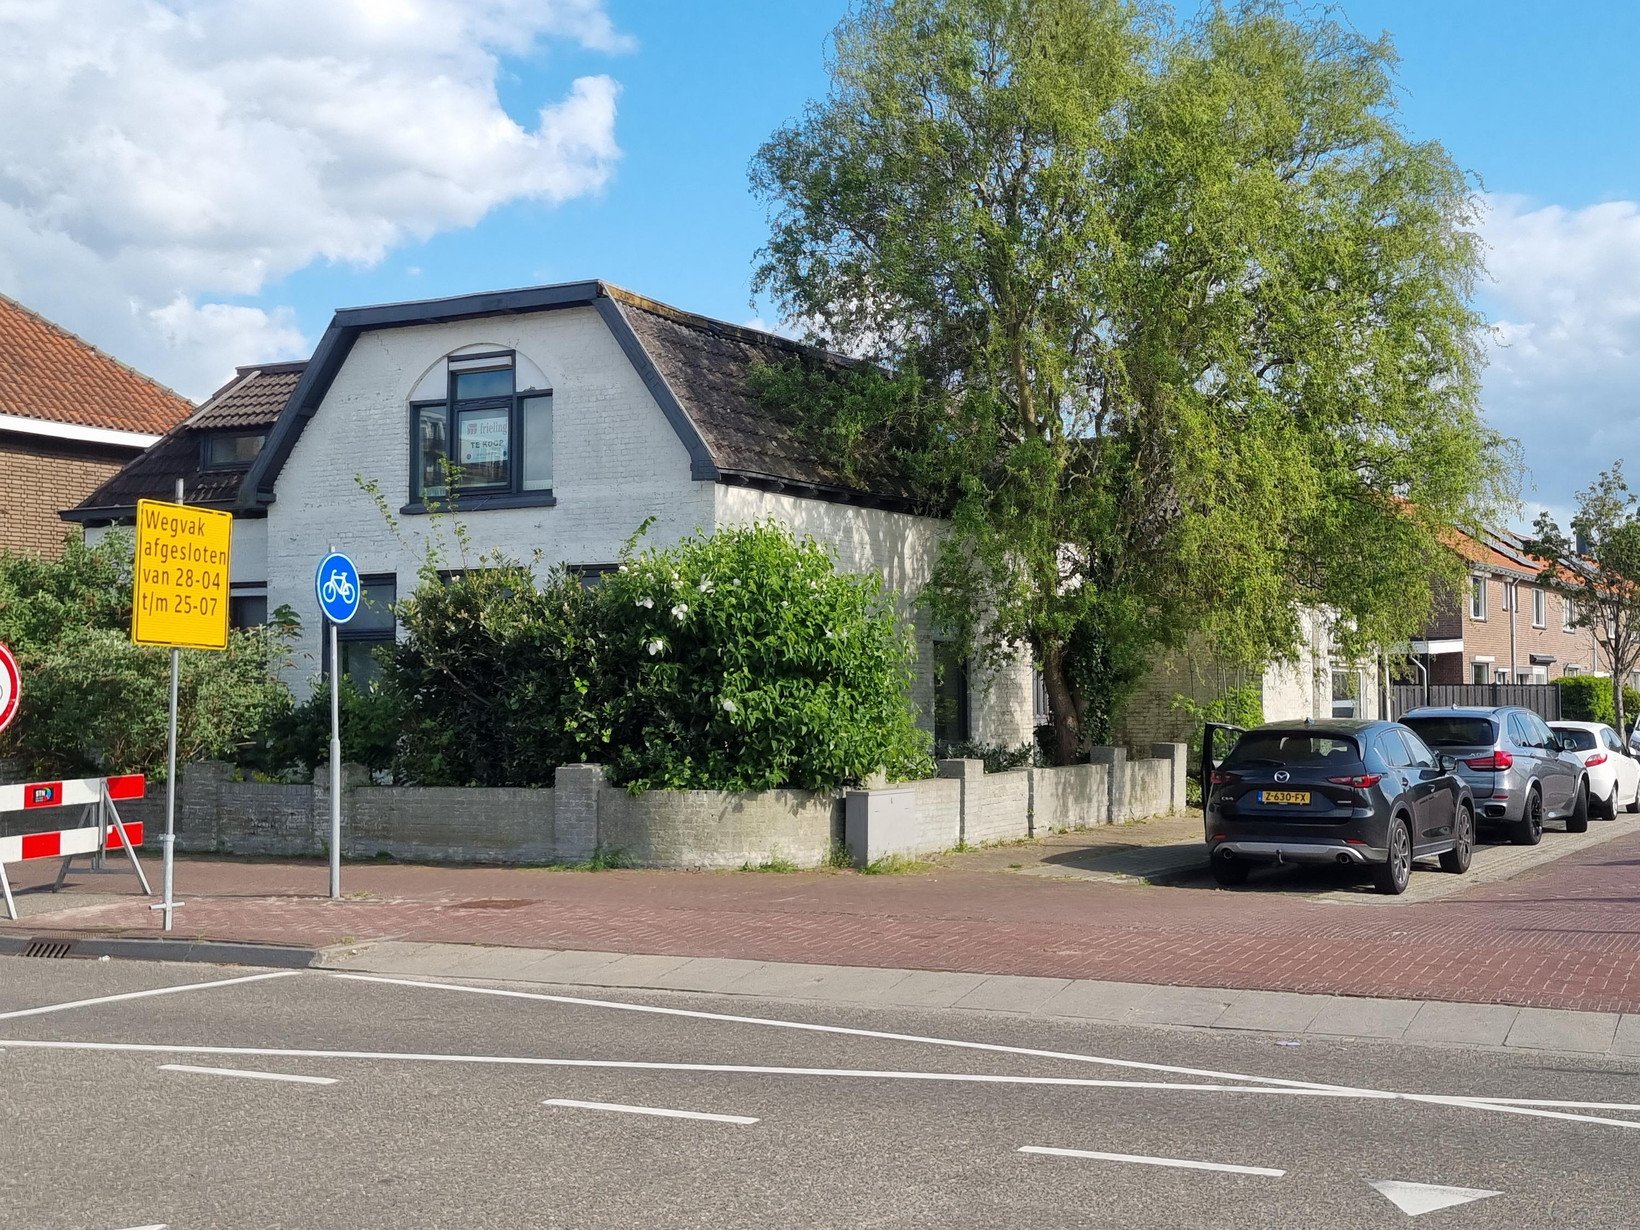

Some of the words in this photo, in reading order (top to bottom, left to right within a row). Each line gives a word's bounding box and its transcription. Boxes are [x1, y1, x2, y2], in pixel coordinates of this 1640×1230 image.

[480, 422, 507, 435] frieling
[482, 440, 504, 448] KOOP
[145, 509, 205, 538] Wegvak
[144, 538, 227, 565] afgesloten
[143, 568, 170, 586] van
[175, 568, 221, 591] 28-04
[142, 591, 168, 616] t/m
[174, 594, 218, 616] 25-07
[1265, 791, 1307, 802] Z-630-FX
